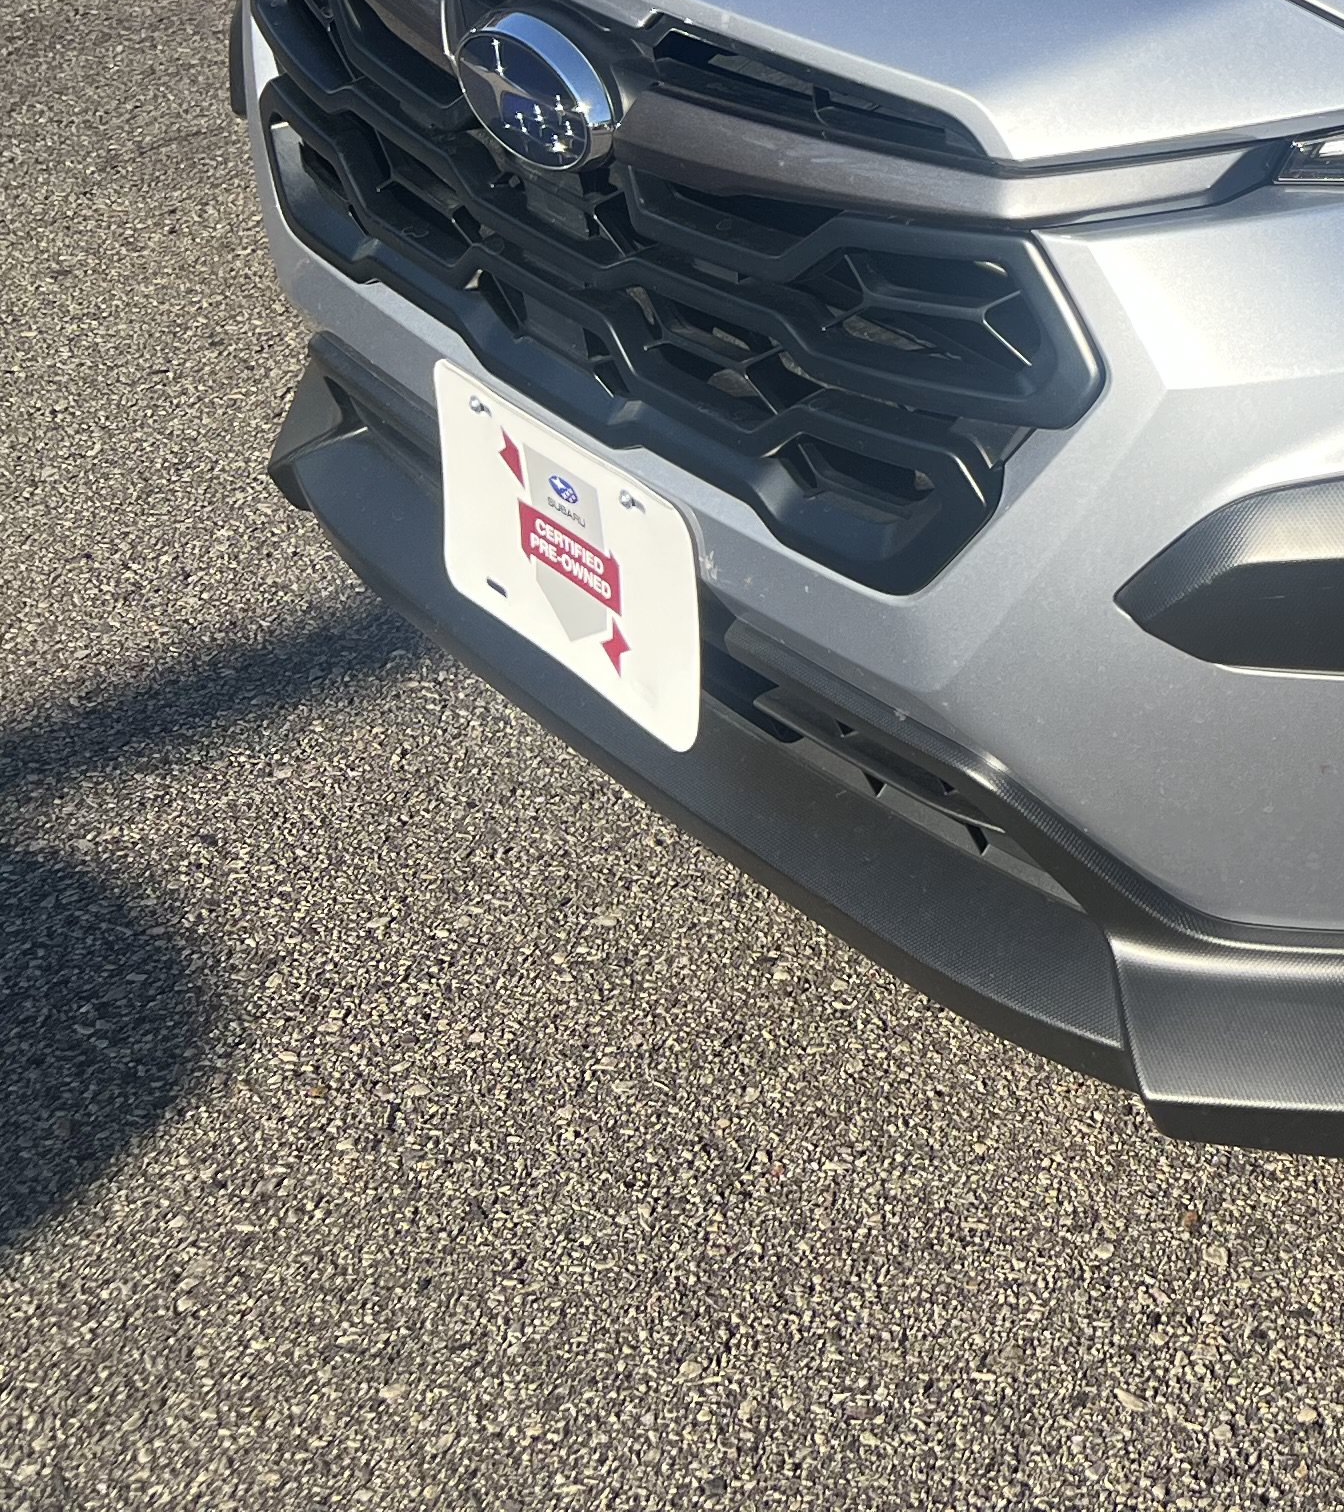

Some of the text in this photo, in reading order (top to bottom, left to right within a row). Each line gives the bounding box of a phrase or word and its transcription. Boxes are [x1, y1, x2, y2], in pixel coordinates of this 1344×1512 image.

[547, 496, 586, 528] SUBARU
[529, 532, 612, 600] PRE-OWNED
[535, 518, 604, 574] CERTIFIED
